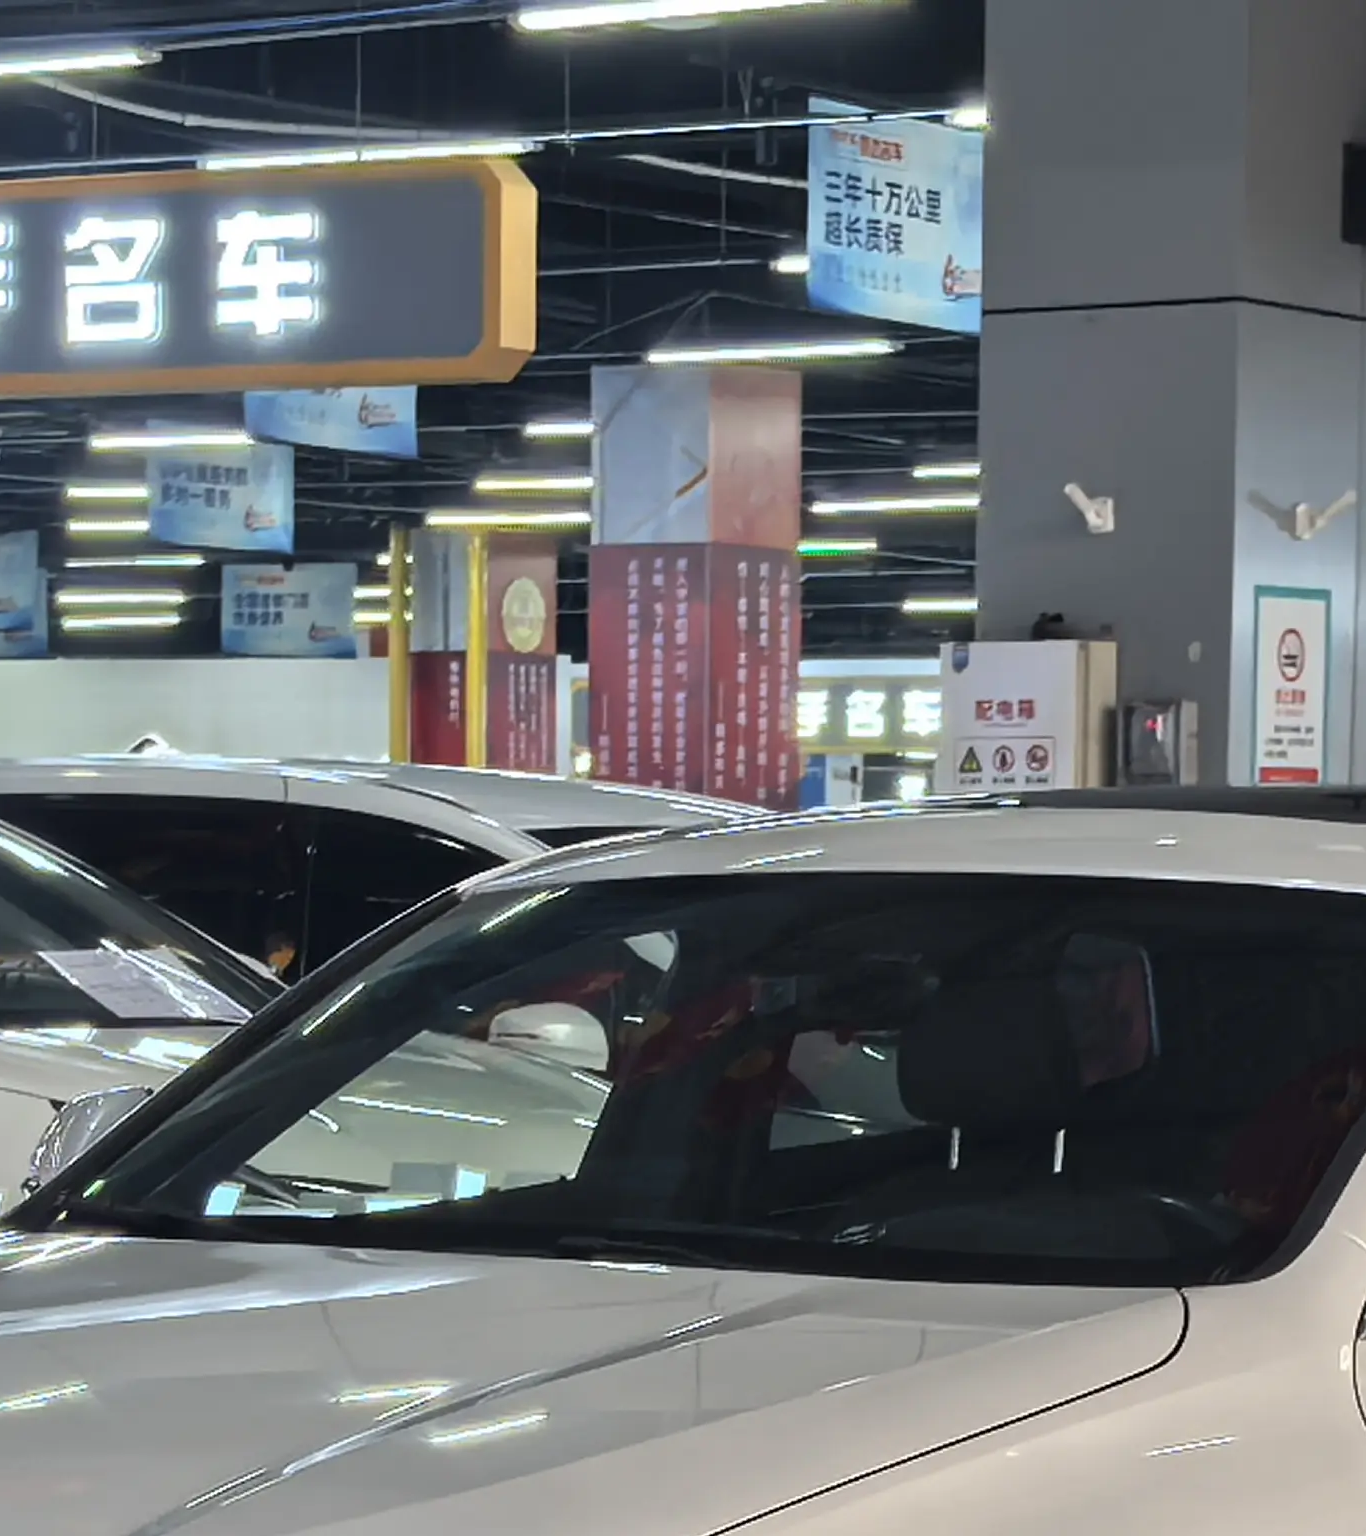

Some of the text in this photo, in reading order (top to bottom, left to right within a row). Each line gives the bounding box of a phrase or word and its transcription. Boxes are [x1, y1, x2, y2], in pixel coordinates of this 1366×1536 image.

[825, 170, 941, 225] 三年十万公里
[825, 211, 903, 256] 超长质保
[975, 699, 1036, 721] 配电箱
